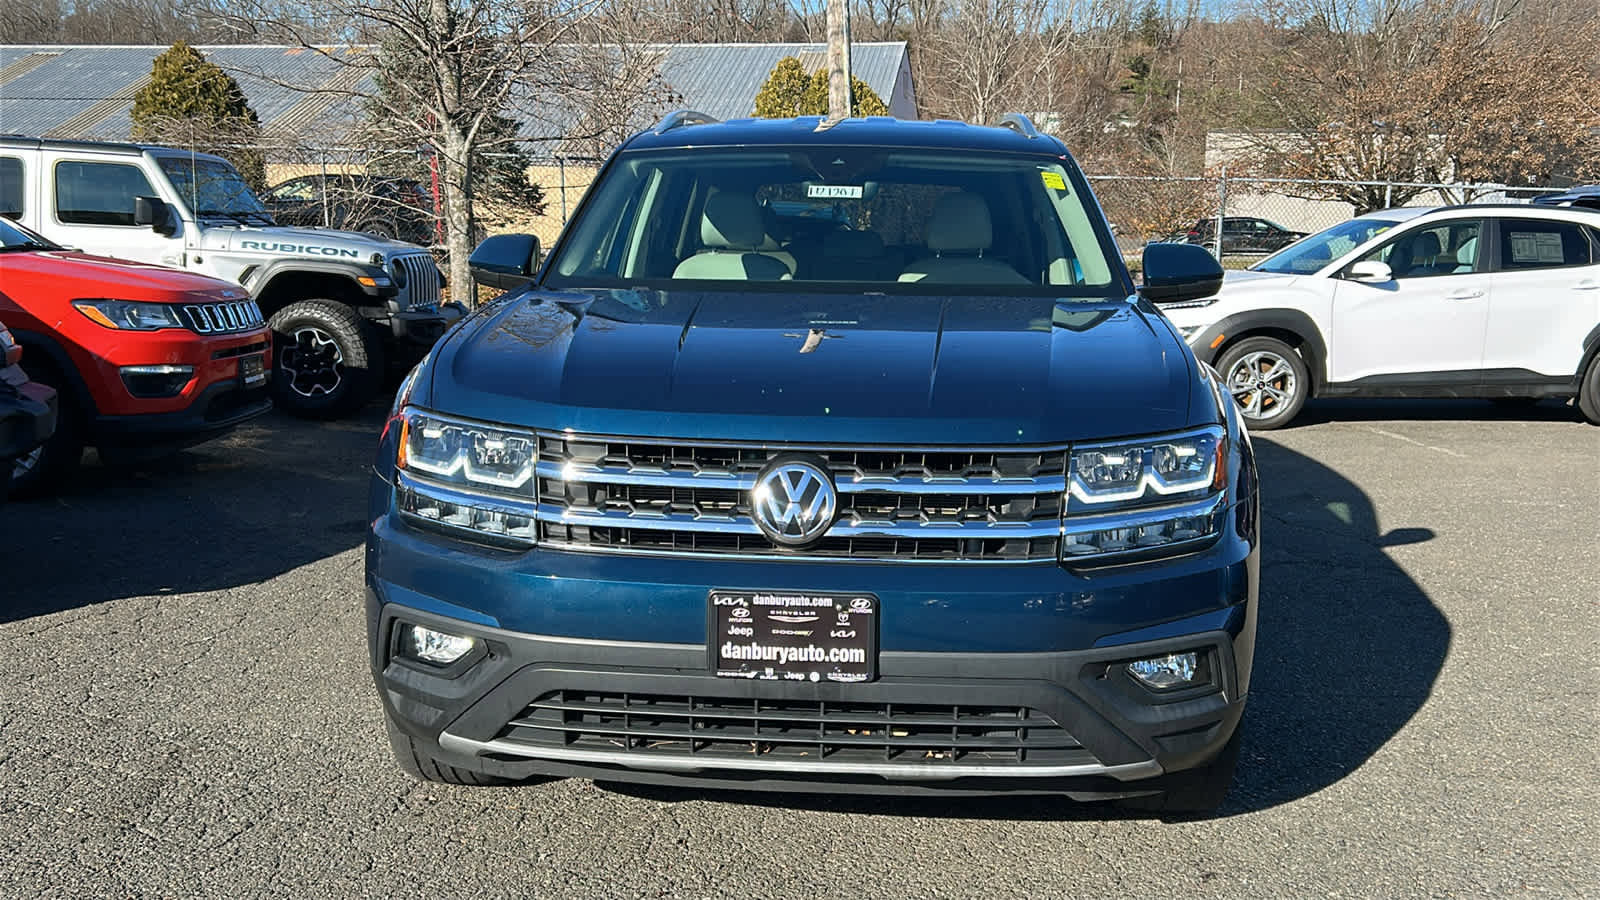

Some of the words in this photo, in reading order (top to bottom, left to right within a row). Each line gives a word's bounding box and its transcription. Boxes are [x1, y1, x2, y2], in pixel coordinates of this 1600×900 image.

[241, 240, 359, 258] RUBICON
[752, 594, 833, 607] danburyauto.com
[728, 625, 753, 637] Jeep
[721, 641, 865, 664] danburyauto.com
[783, 671, 805, 681] Jeep
